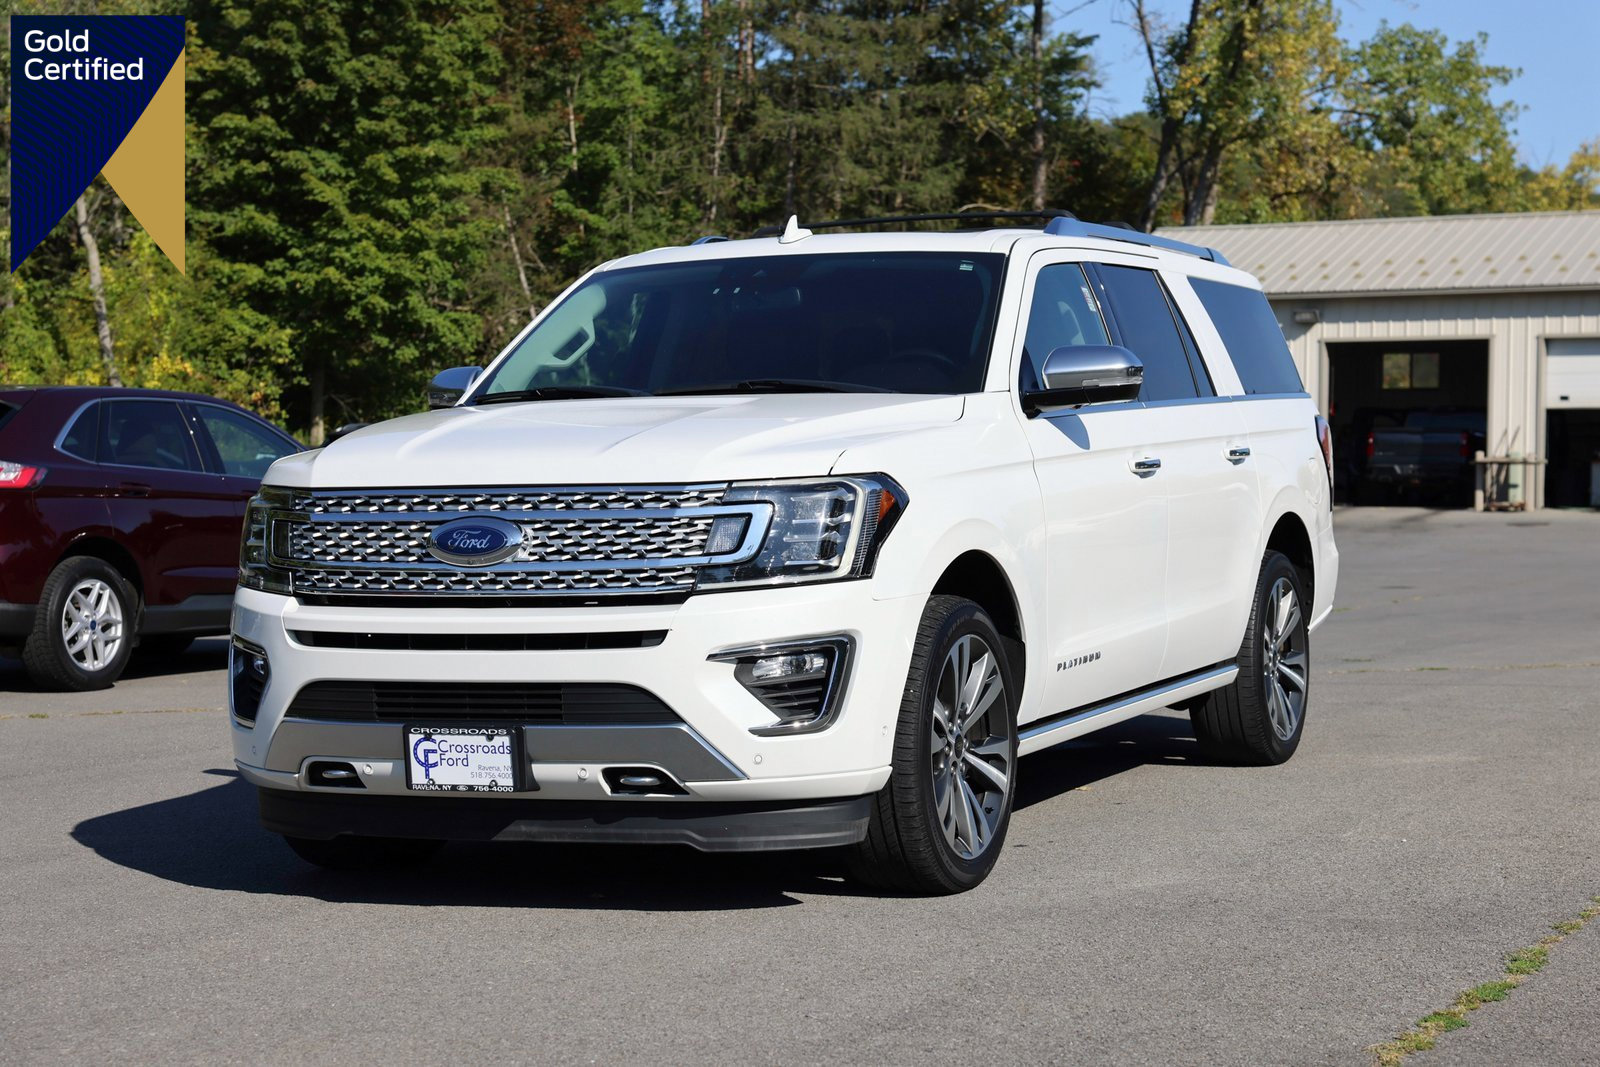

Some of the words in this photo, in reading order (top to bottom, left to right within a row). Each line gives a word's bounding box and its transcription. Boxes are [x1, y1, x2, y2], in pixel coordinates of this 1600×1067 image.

[448, 530, 492, 549] Ford
[1056, 650, 1102, 673] PLATINUM
[411, 727, 507, 735] CROSSROADS
[437, 739, 512, 755] Crossroads
[439, 753, 469, 767] Ford
[478, 764, 502, 772] Ravena,
